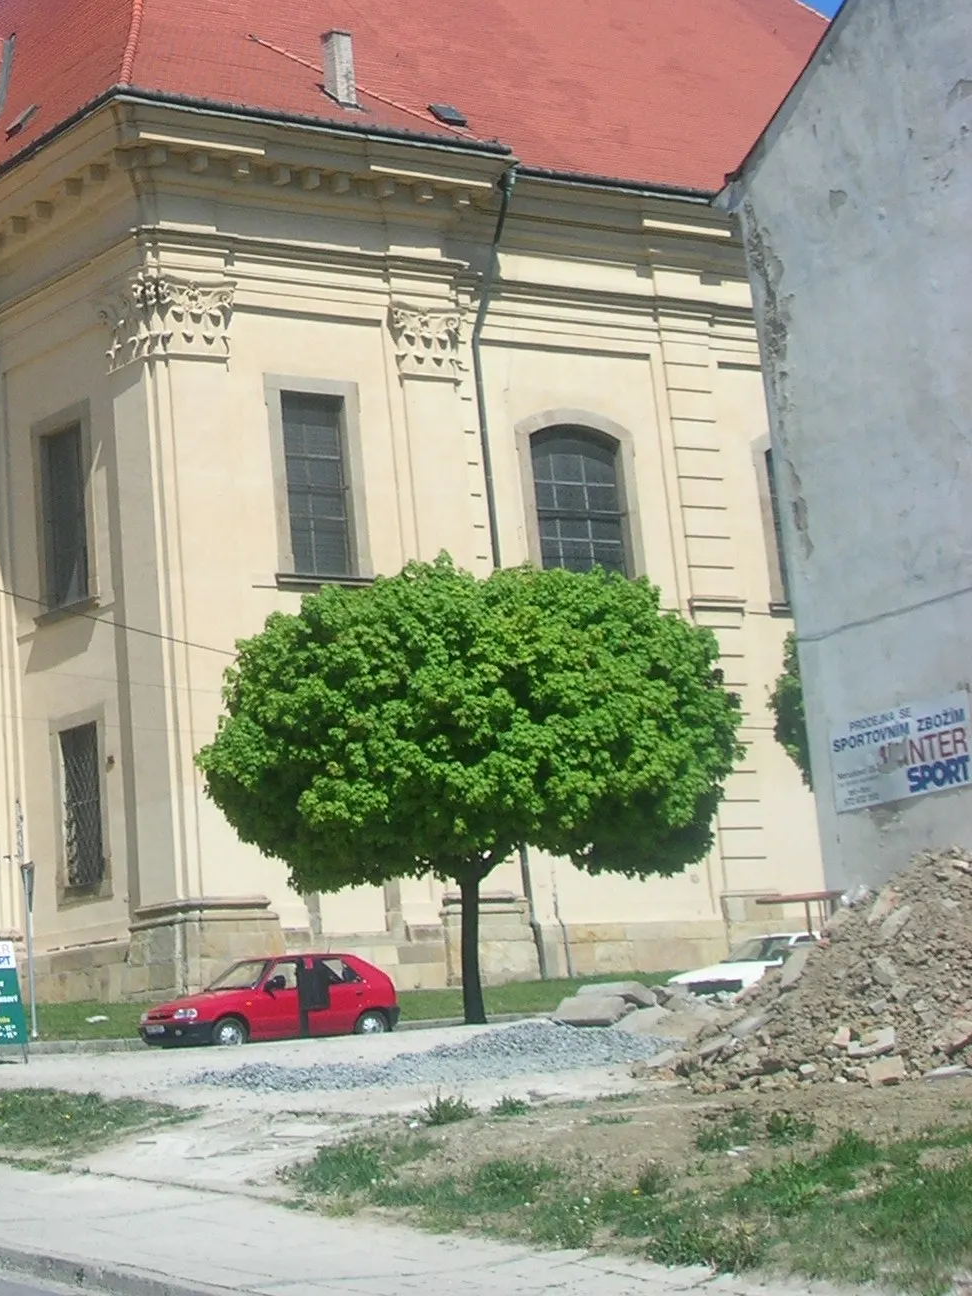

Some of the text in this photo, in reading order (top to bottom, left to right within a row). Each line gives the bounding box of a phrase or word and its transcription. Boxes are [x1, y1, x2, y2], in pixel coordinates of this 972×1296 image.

[832, 706, 965, 753] SPORTOVNÍM ZBOŽÍM
[849, 708, 912, 732] PRODEJNA SE
[906, 754, 970, 793] SPORT
